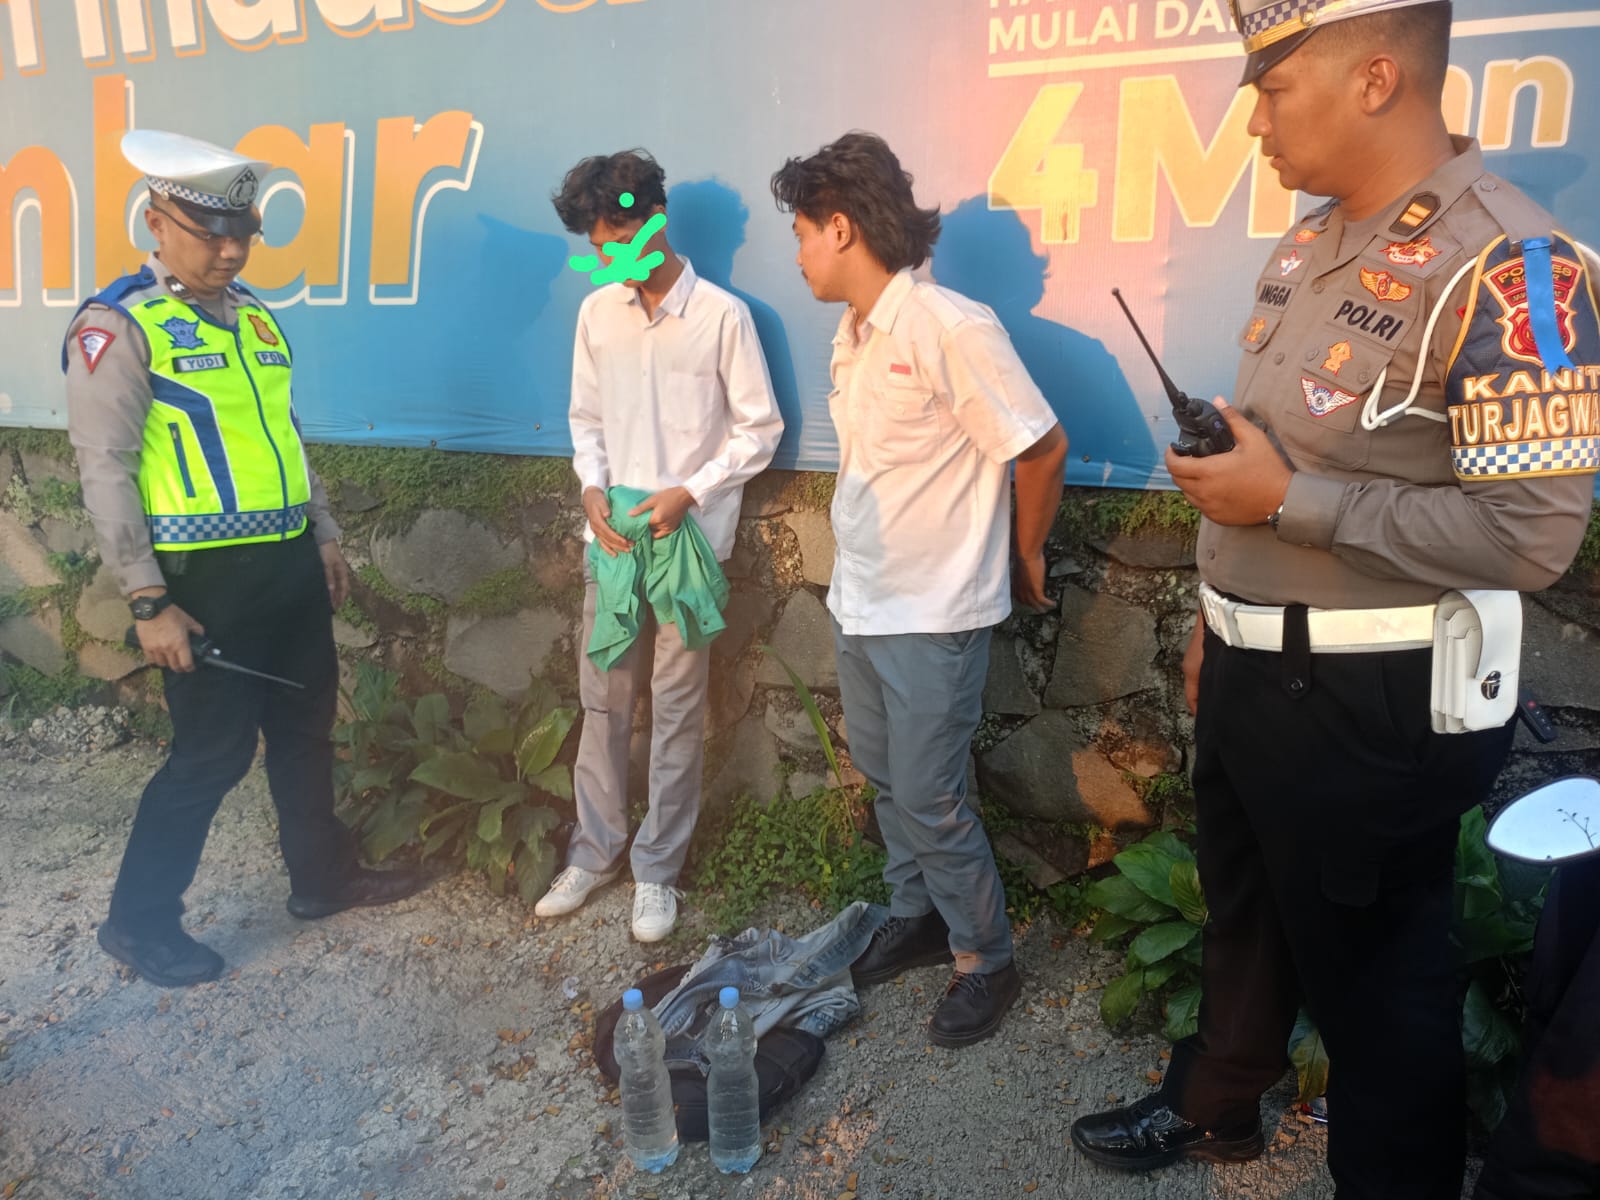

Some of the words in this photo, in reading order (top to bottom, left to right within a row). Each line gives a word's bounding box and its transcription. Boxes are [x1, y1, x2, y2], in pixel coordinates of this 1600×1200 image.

[989, 3, 1138, 55] MULAI
[1154, 0, 1243, 39] DA
[1497, 264, 1572, 284] POES
[1333, 300, 1404, 342] POLRI
[187, 356, 220, 369] YUDI
[1463, 365, 1600, 401] KANIT
